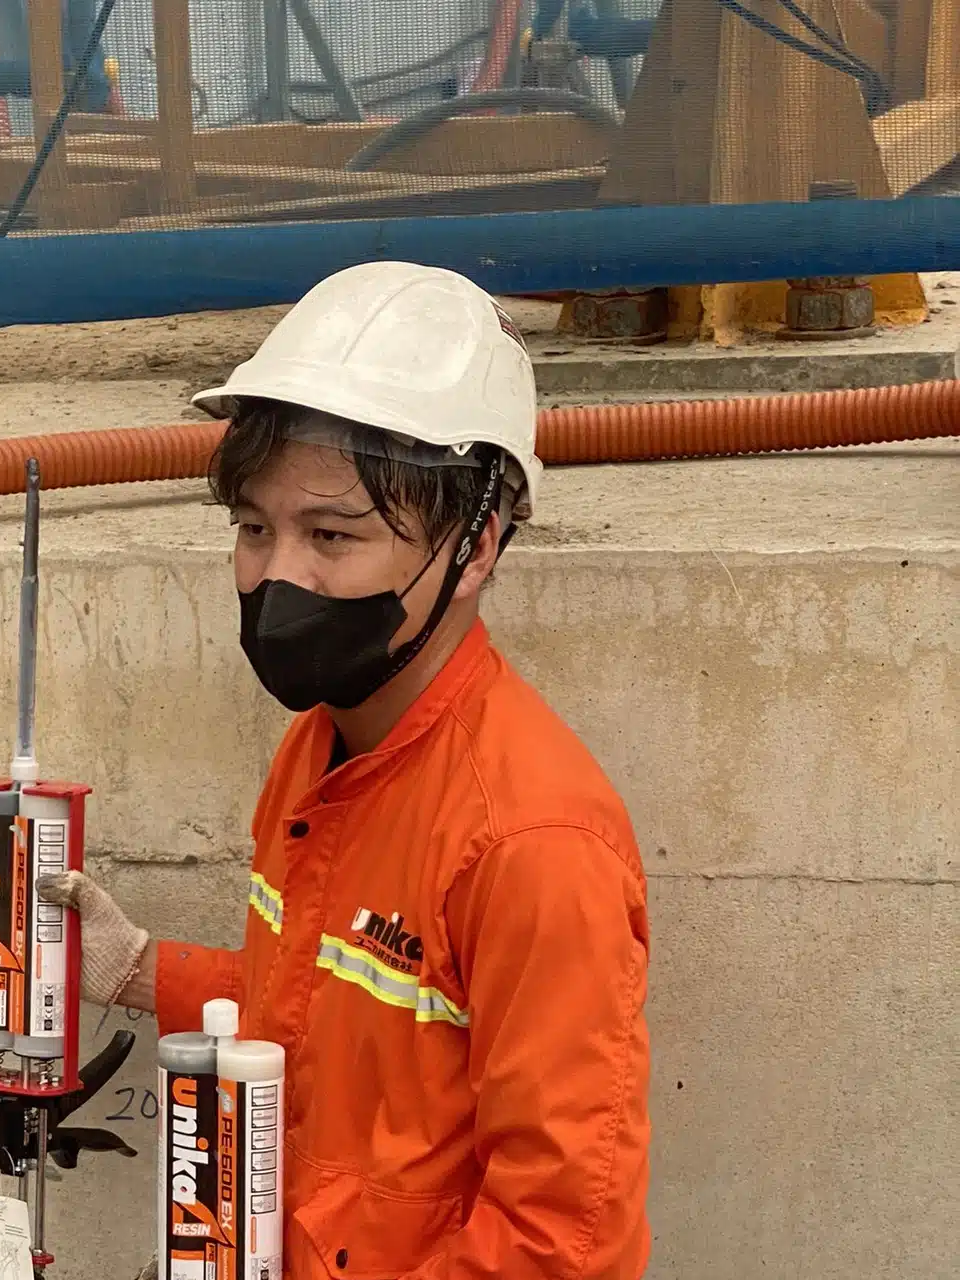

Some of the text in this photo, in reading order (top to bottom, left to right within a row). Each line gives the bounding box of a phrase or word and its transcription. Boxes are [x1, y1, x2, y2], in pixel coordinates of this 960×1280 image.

[172, 1077, 209, 1205] unika
[221, 1116, 233, 1230] PE-600EX
[172, 1223, 211, 1237] RESIN
